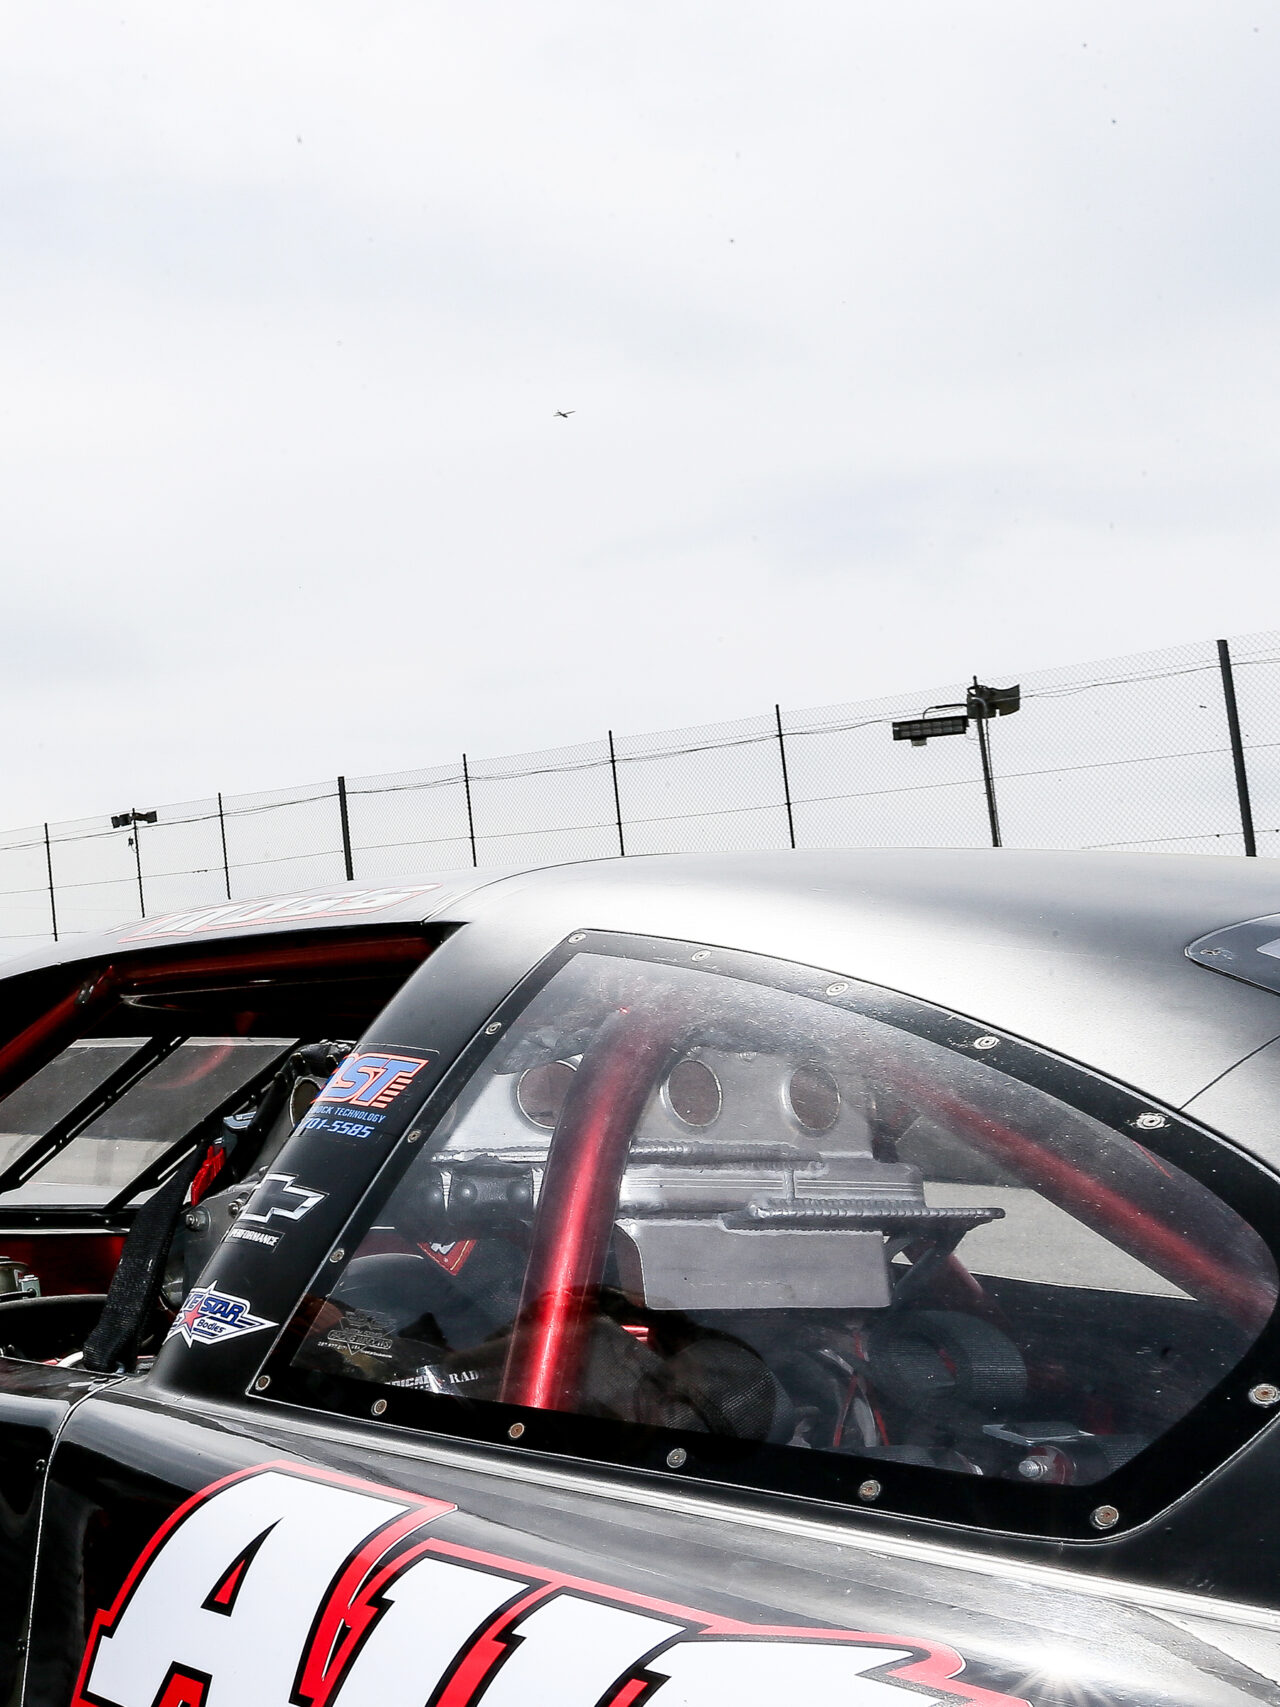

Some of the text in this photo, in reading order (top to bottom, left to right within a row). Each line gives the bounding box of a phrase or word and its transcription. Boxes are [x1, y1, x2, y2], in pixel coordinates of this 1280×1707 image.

[334, 1108, 387, 1124] TECHNOLOGY
[229, 1228, 279, 1246] PERFORMANCE
[200, 1297, 244, 1323] STAR
[197, 1319, 226, 1333] Bodies
